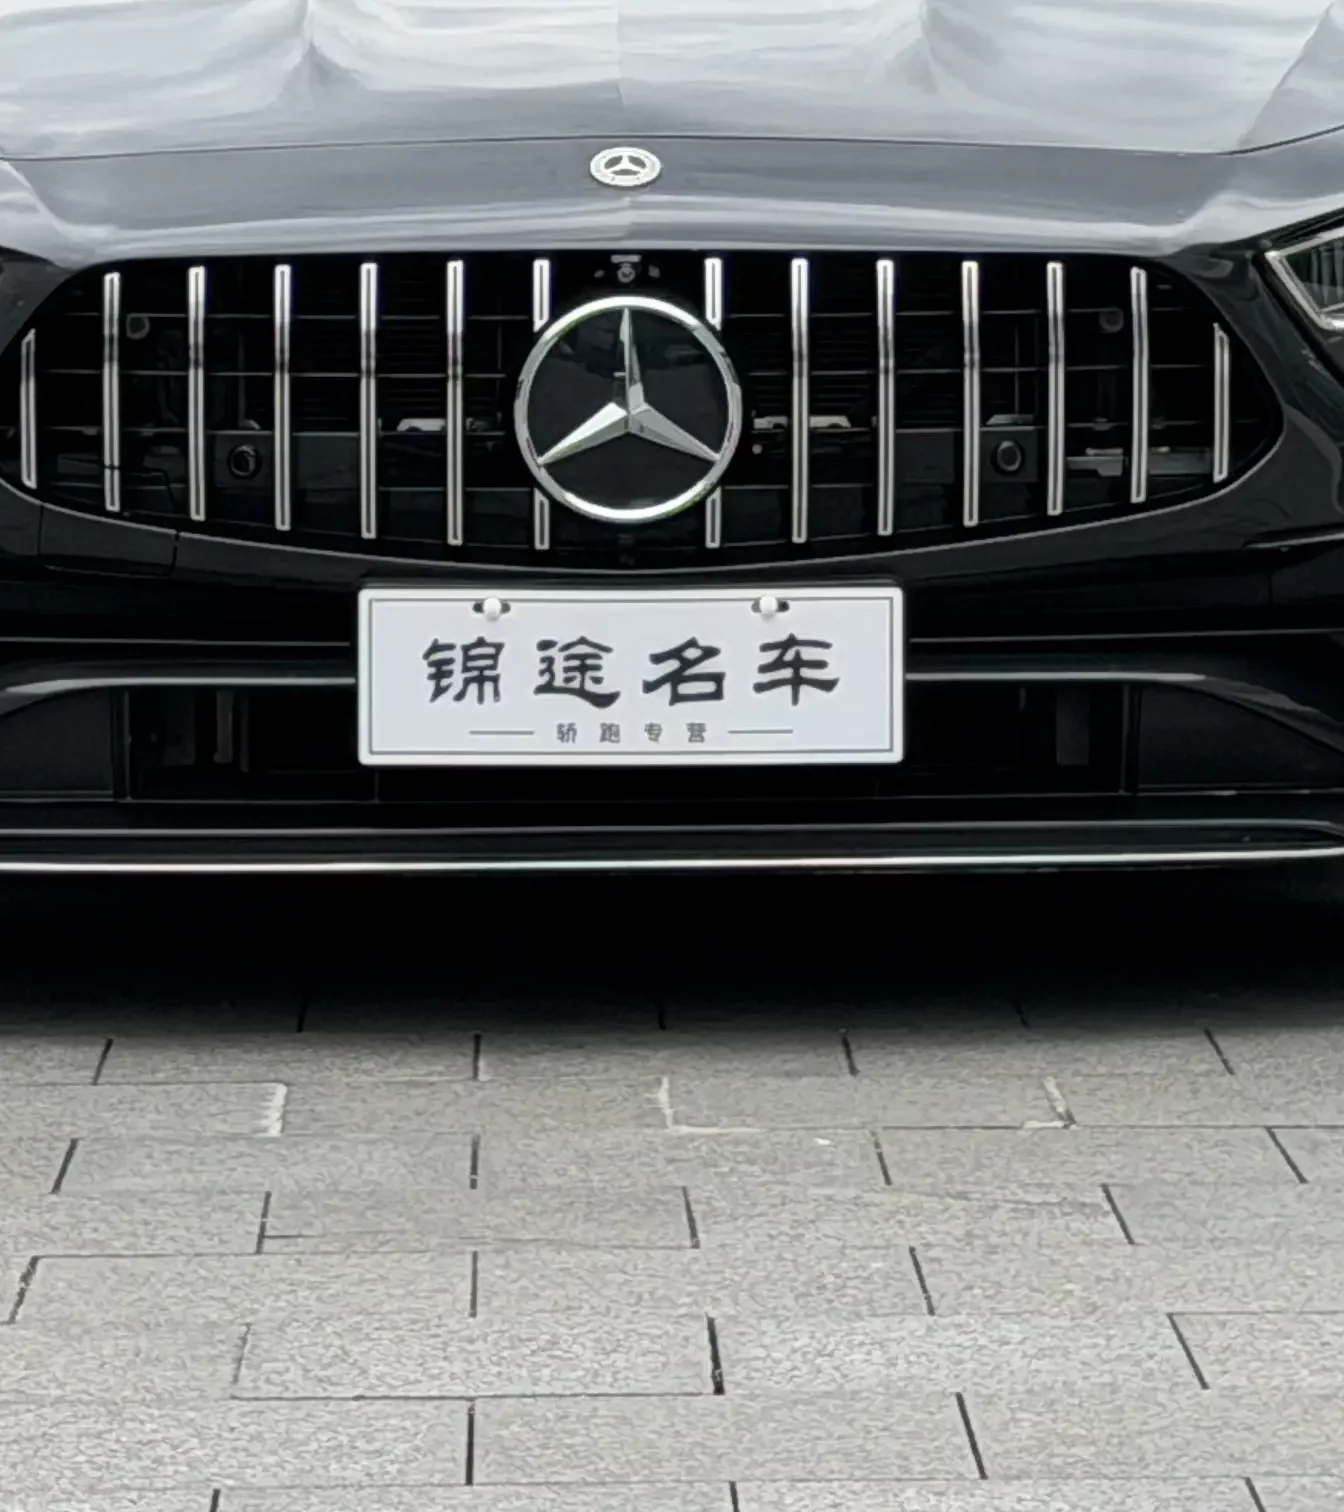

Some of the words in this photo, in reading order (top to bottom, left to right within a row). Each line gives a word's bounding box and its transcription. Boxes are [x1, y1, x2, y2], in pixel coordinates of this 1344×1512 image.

[422, 633, 840, 709] 锦途名车
[556, 722, 708, 744] 轿跑专营
